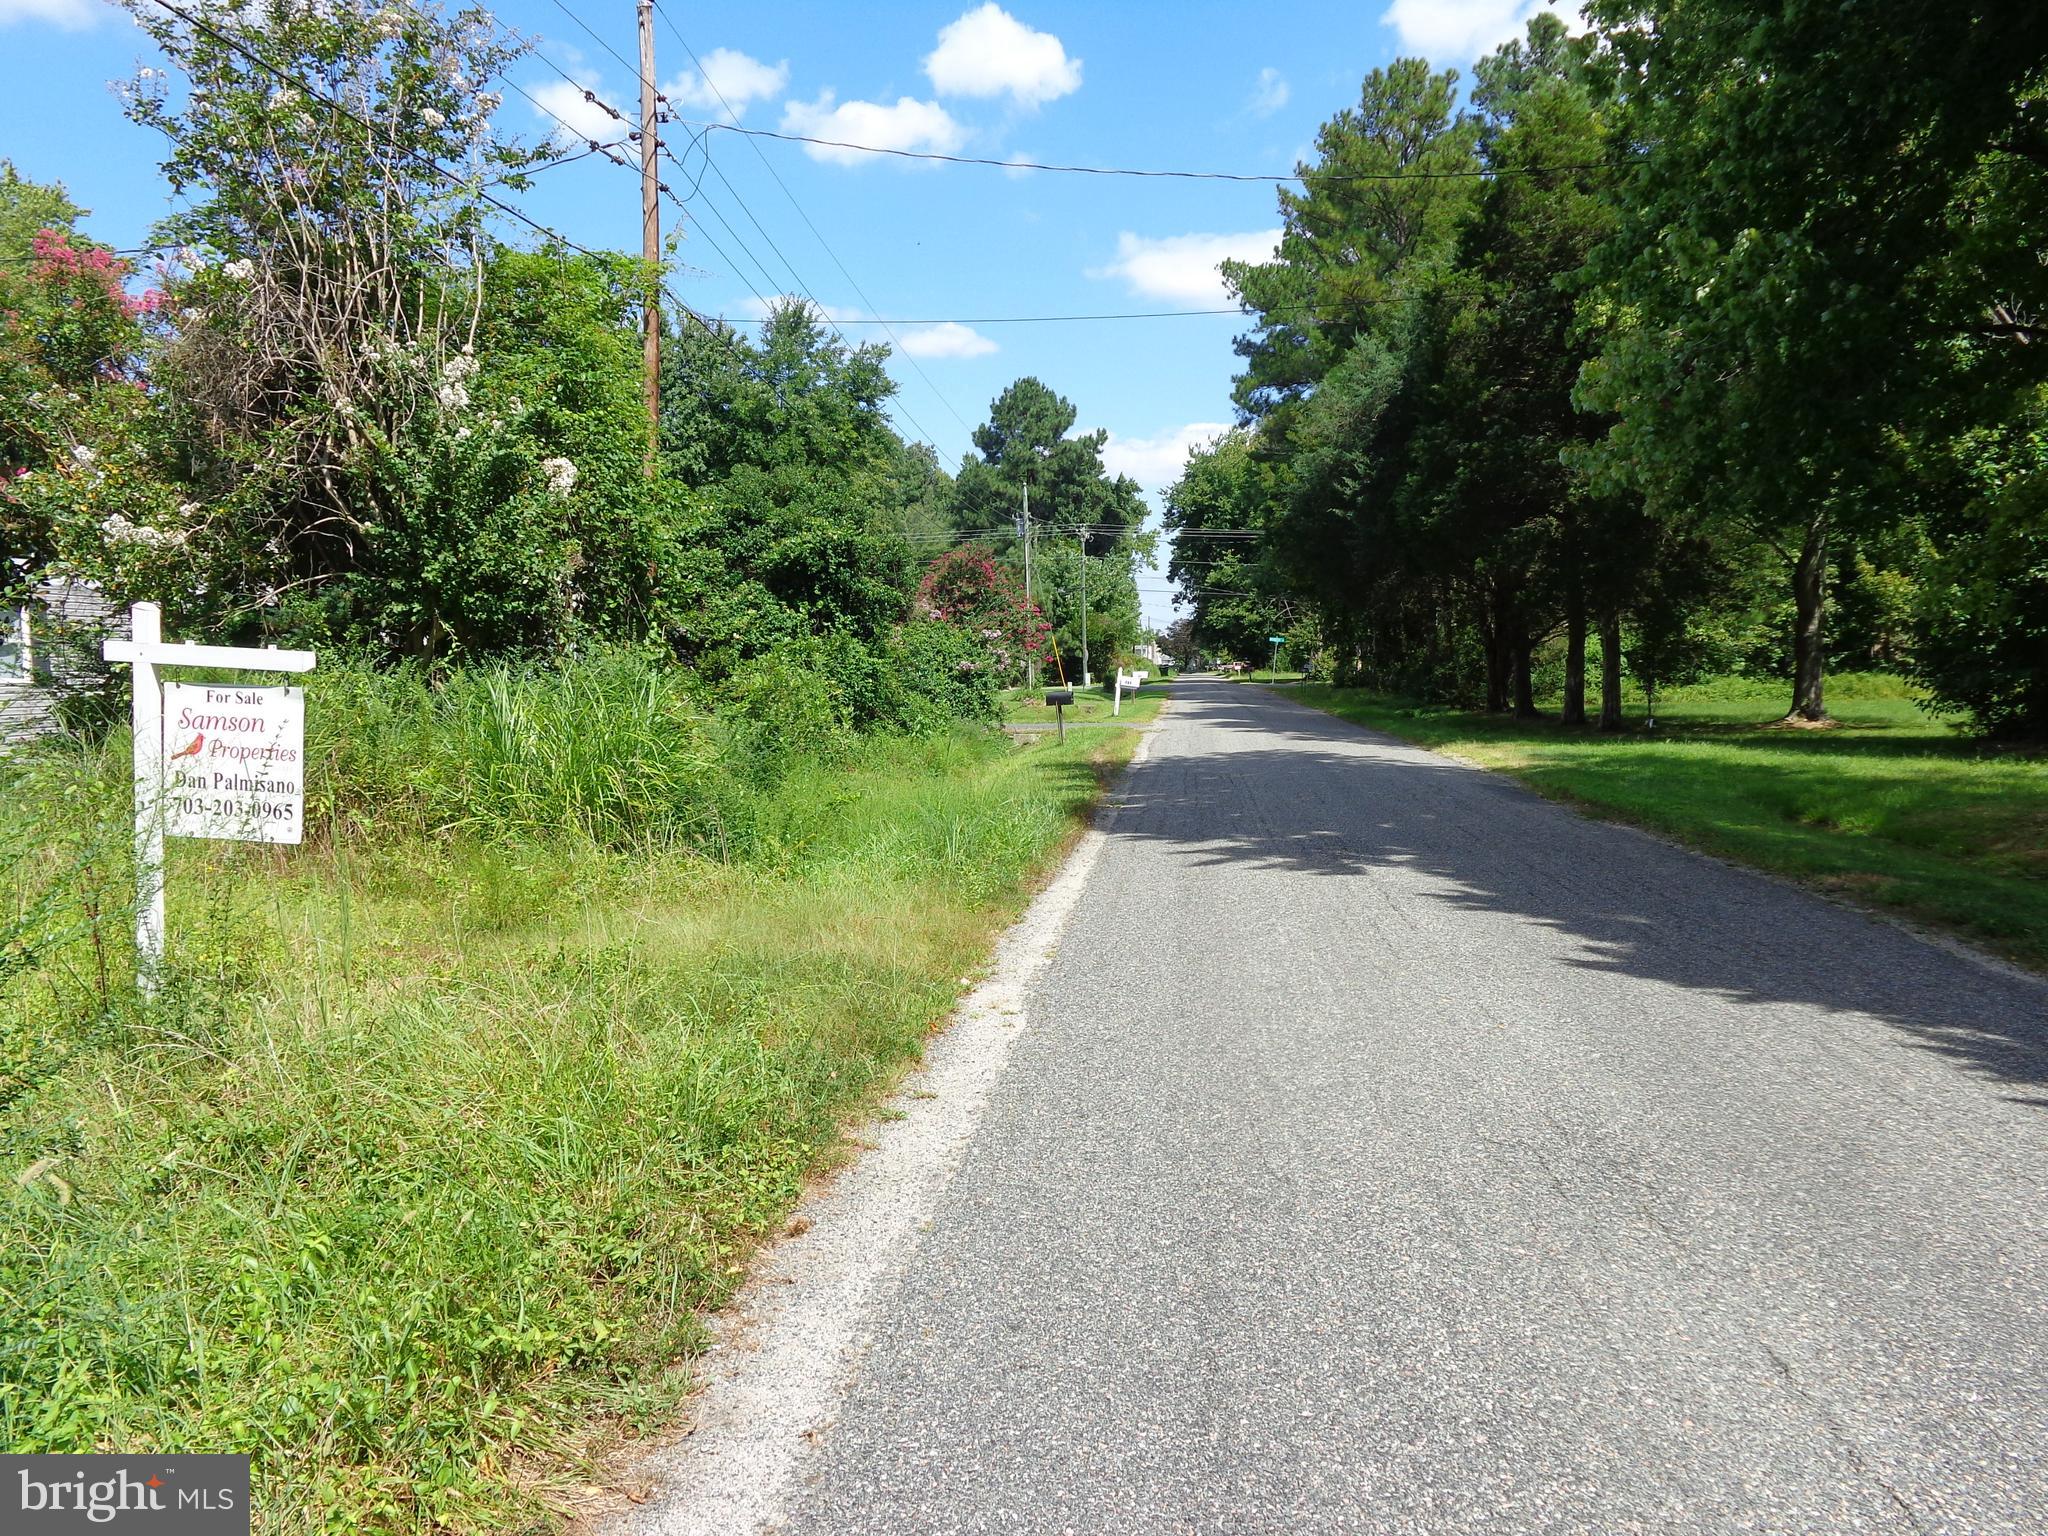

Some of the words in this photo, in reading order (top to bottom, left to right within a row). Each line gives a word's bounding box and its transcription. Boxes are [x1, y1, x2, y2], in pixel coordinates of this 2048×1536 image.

[206, 689, 231, 704] For
[235, 690, 264, 706] Sale
[177, 707, 266, 733] Samson
[208, 738, 297, 764] Properties
[174, 770, 206, 789] Dan
[213, 772, 295, 795] Palmisano
[173, 797, 294, 821] 703-203-0965
